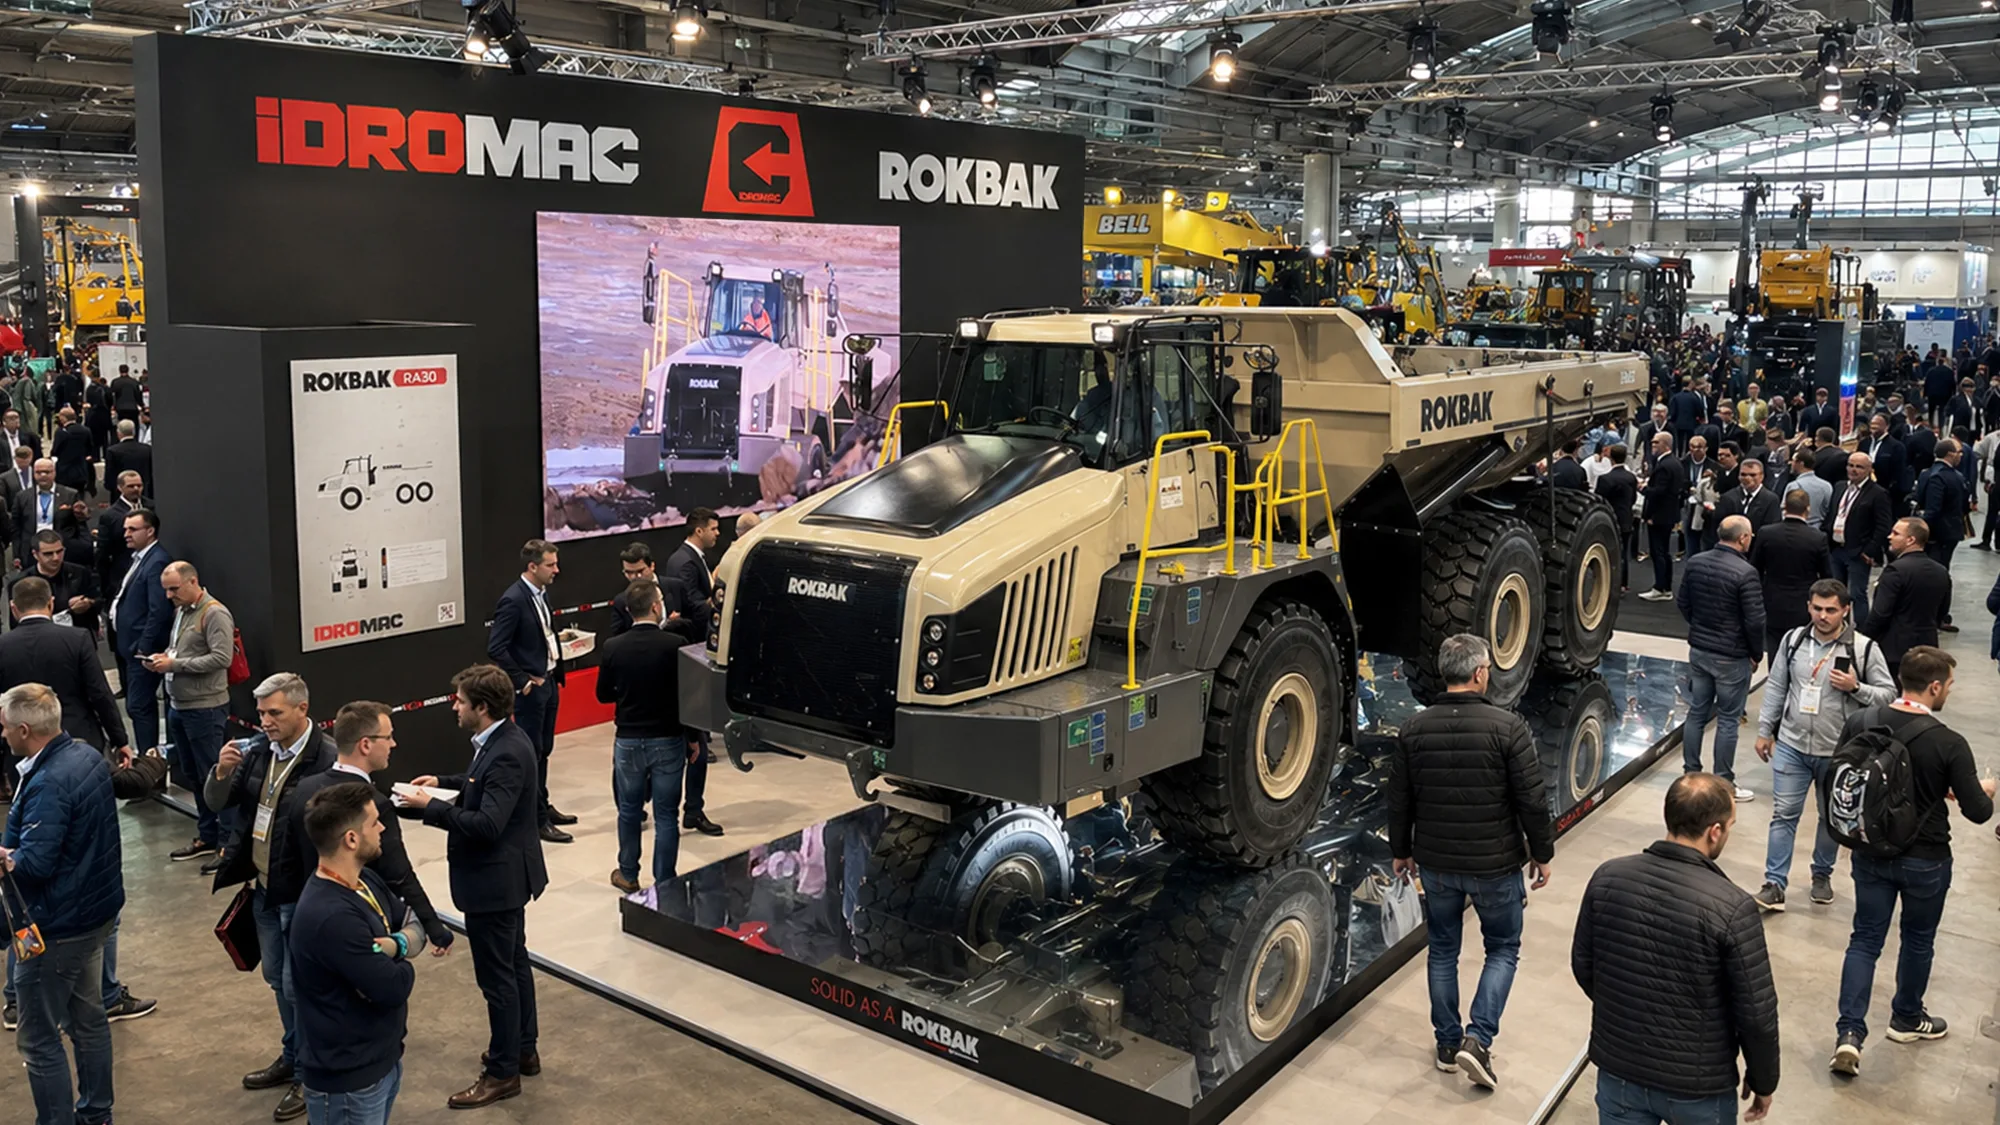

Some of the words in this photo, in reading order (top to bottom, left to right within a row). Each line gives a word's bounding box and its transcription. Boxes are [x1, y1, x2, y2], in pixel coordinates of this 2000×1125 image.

[879, 151, 1060, 210] ROKBAK
[1098, 214, 1150, 234] BELL
[302, 370, 391, 392] ROKBAK
[403, 371, 437, 384] RA30
[1421, 390, 1493, 432] ROKBAK
[787, 576, 848, 602] ROKBAK
[810, 977, 856, 1008] SOLID
[860, 997, 880, 1018] AS
[884, 1006, 896, 1025] A
[901, 1010, 979, 1058] ROKBAK
